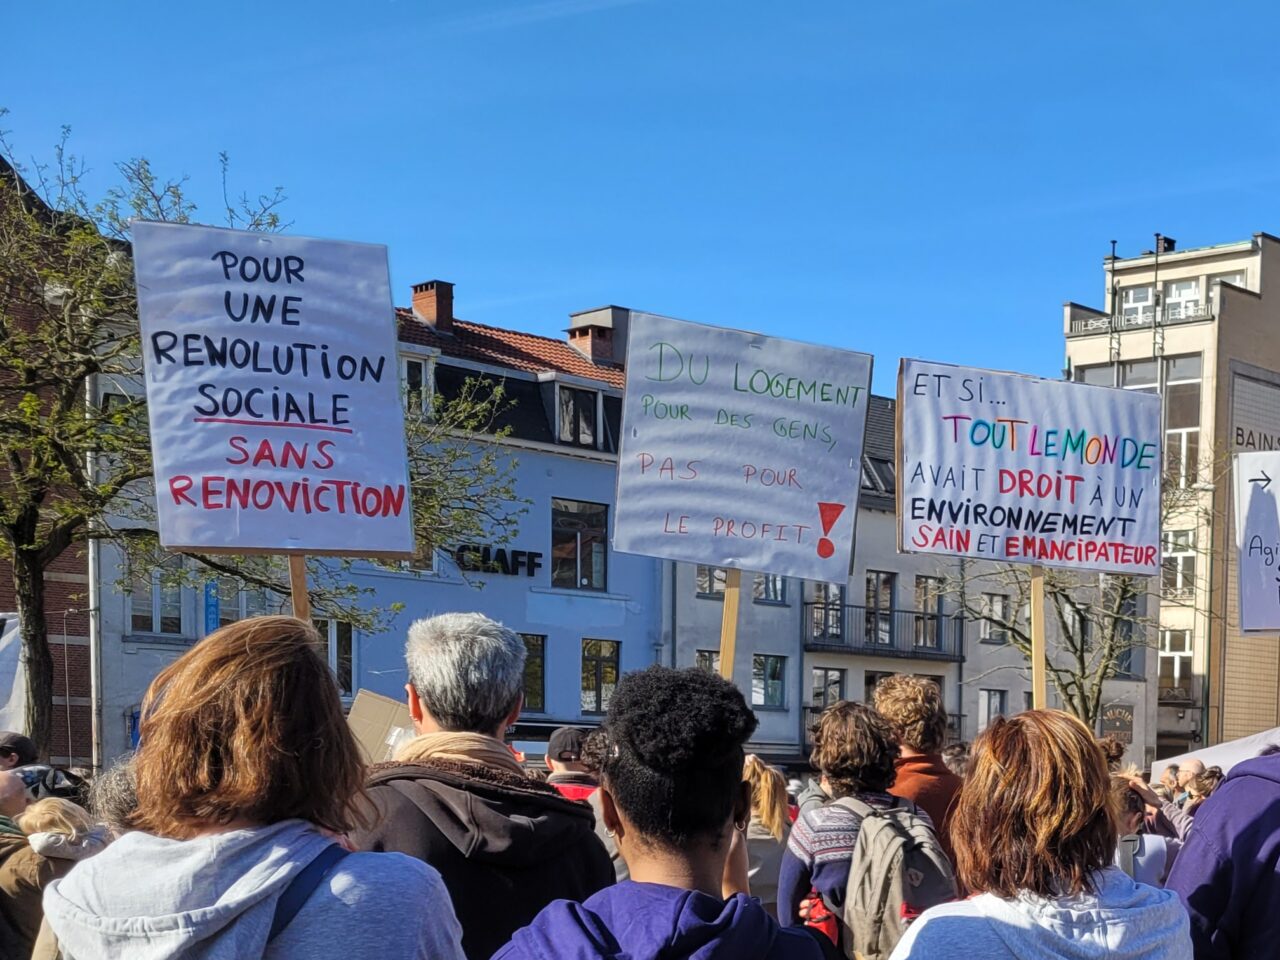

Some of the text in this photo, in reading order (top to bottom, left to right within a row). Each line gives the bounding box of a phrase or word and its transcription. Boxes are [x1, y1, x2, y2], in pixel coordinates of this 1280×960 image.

[211, 250, 305, 285] POUR
[224, 290, 302, 326] UNE
[644, 342, 867, 408] DU LOGEMENT
[913, 373, 951, 398] ET
[641, 393, 837, 451] POUR DES GENS,
[942, 415, 1029, 451] TOUT
[225, 436, 336, 470] SANS
[636, 452, 803, 489] PAS POUR
[1114, 487, 1144, 509] UN
[664, 512, 690, 534] LE
[712, 516, 811, 544] PROFIT
[977, 533, 1000, 554] ET
